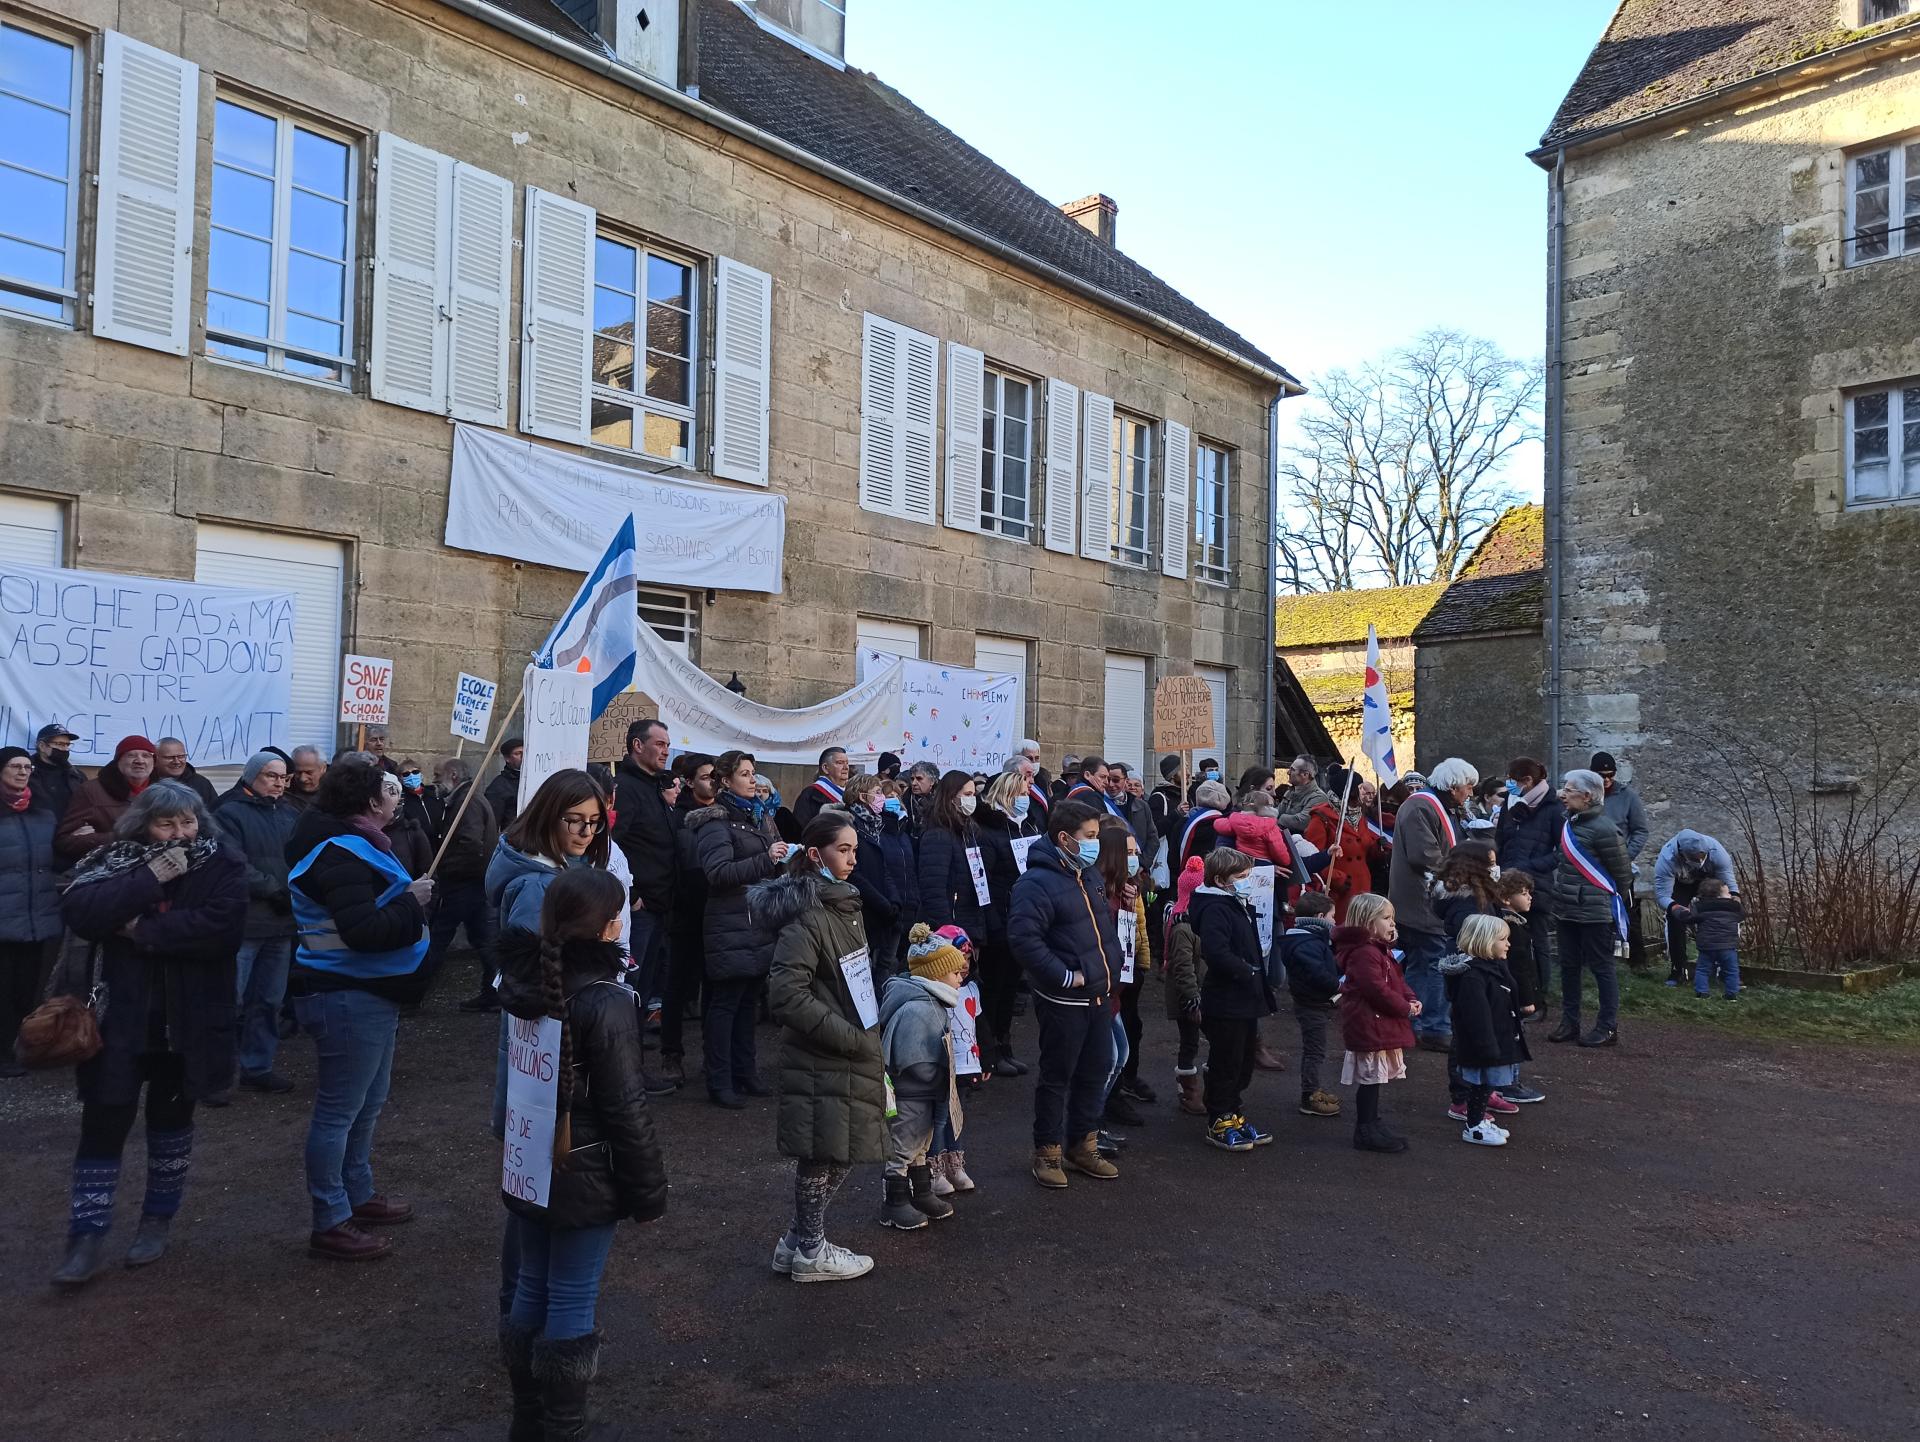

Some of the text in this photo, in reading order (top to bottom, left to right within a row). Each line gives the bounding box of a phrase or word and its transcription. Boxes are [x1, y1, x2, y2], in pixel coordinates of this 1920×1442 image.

[653, 486, 712, 512] POISSONS
[497, 493, 533, 528] PAS
[646, 532, 716, 561] SARDINES
[155, 594, 222, 635] PAS
[248, 600, 293, 643] MA
[0, 624, 284, 674] ASSE GARDONS
[347, 662, 391, 687] SAVE
[90, 672, 198, 704] NOTRE
[356, 685, 385, 701] OUR
[461, 677, 495, 699] ECOLE
[962, 687, 1009, 704] CHAMPLEMY
[343, 700, 386, 715] SCHOOL
[456, 691, 489, 712] FERMÉE
[356, 713, 385, 723] PLEASE
[600, 706, 647, 719] NOUIR
[1156, 707, 1177, 720] NOUS
[602, 716, 651, 731] ENFAN
[1161, 726, 1208, 747] REMPARTS
[513, 1017, 540, 1048] NOUS
[520, 1115, 533, 1140] DE
